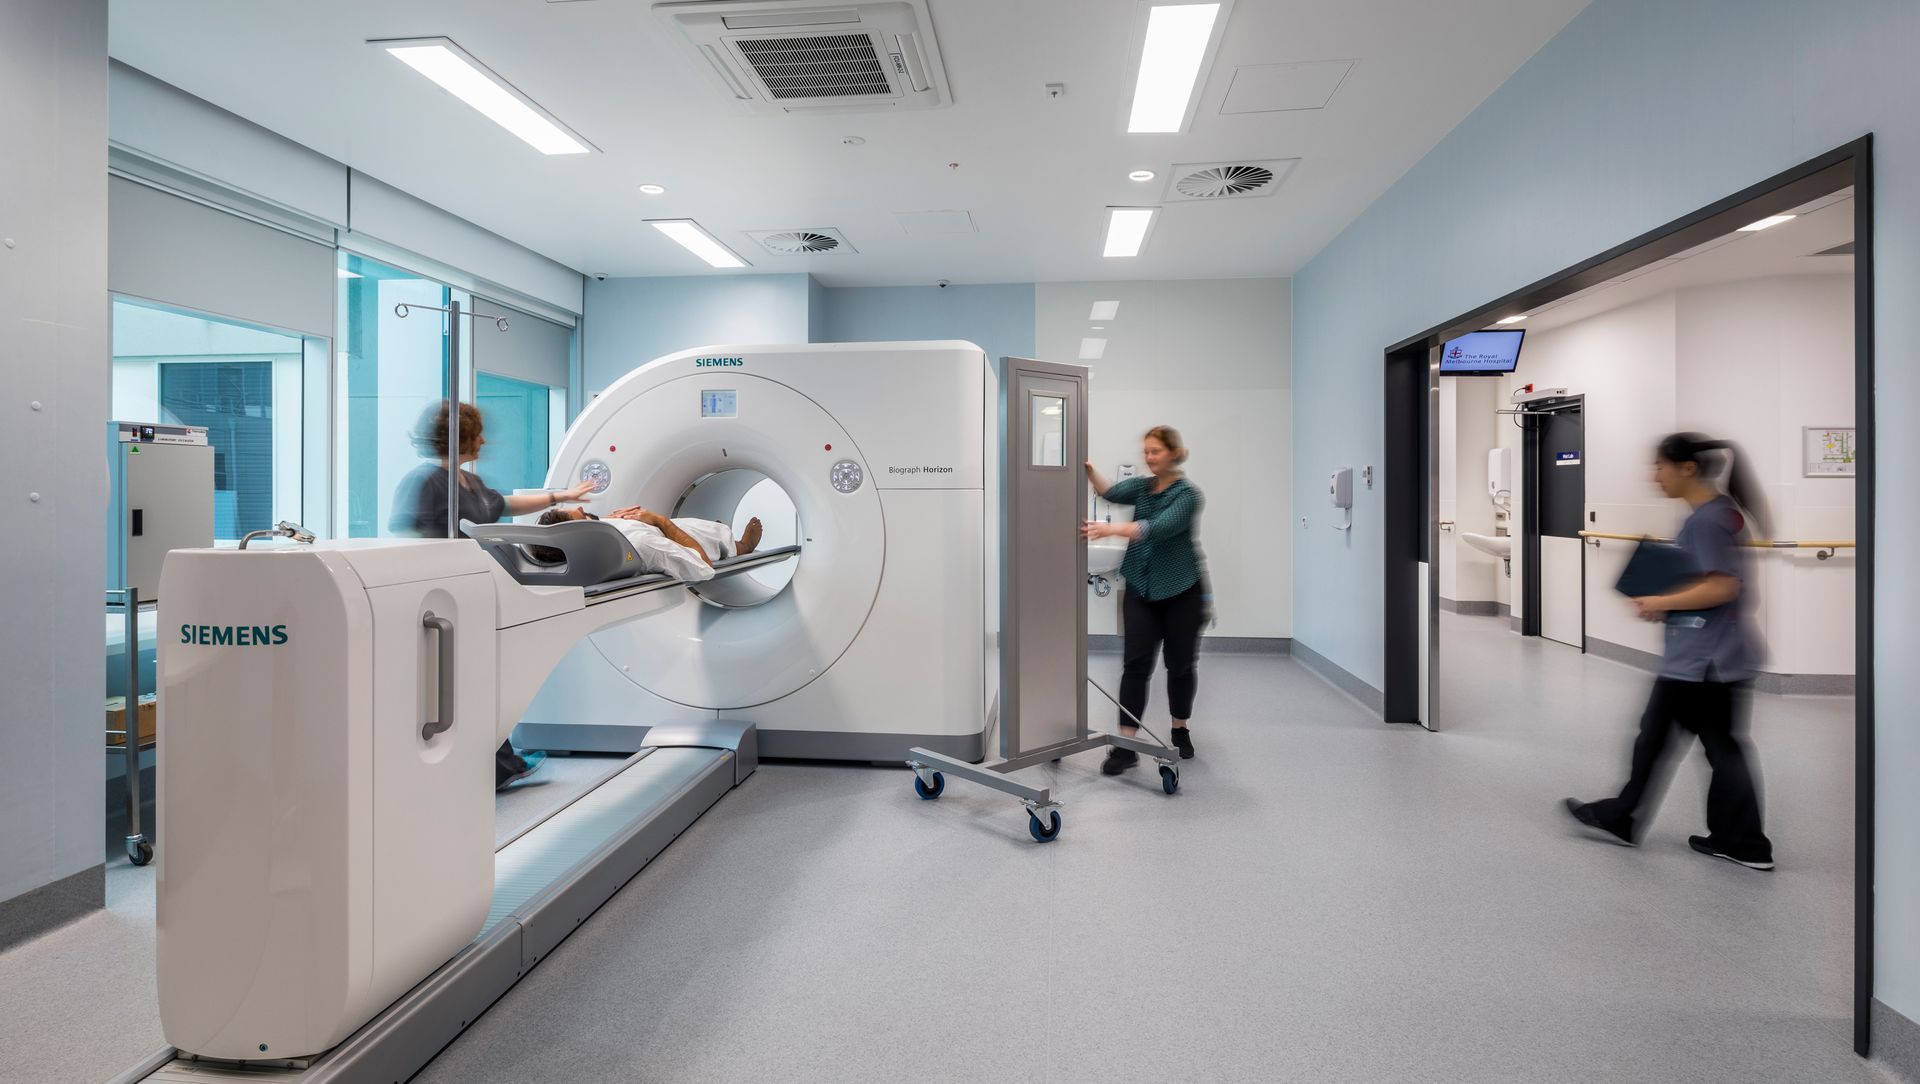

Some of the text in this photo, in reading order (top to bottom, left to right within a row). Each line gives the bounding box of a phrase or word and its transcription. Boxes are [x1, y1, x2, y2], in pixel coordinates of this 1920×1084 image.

[695, 357, 744, 367] SIEMENS
[888, 465, 953, 475] Biograph Horizon
[180, 623, 289, 646] SIEMENS
